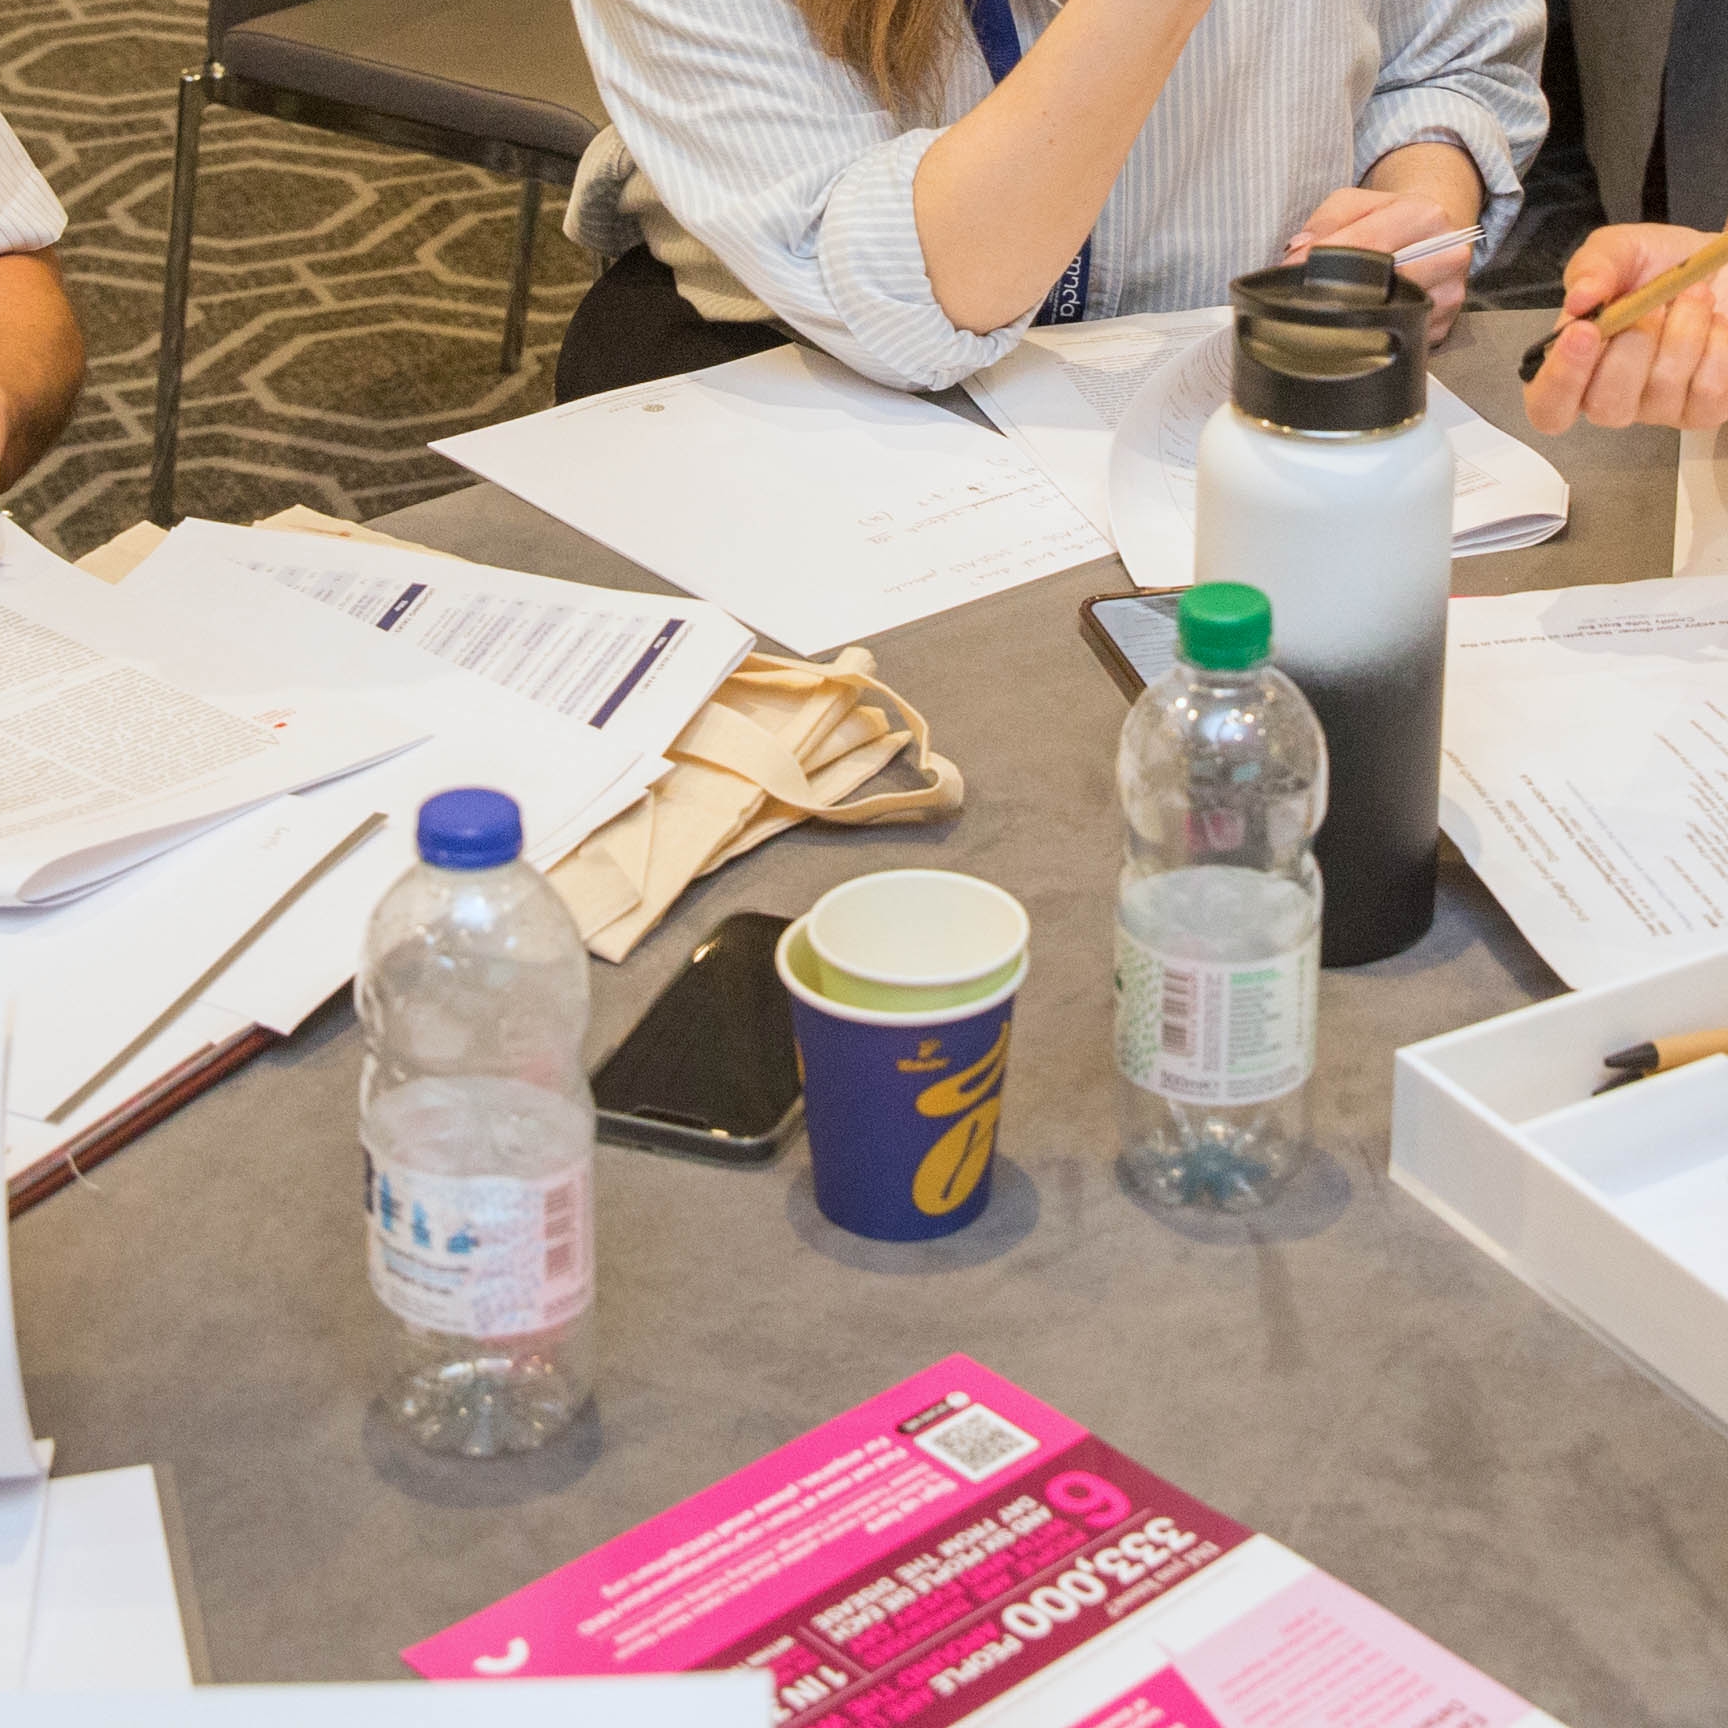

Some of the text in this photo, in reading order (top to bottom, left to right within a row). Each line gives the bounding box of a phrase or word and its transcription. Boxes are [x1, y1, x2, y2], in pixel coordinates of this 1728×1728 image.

[1044, 1470, 1132, 1528] 6
[1000, 1517, 1197, 1640] 333,000
[928, 1638, 1025, 1695] PEOPLE
